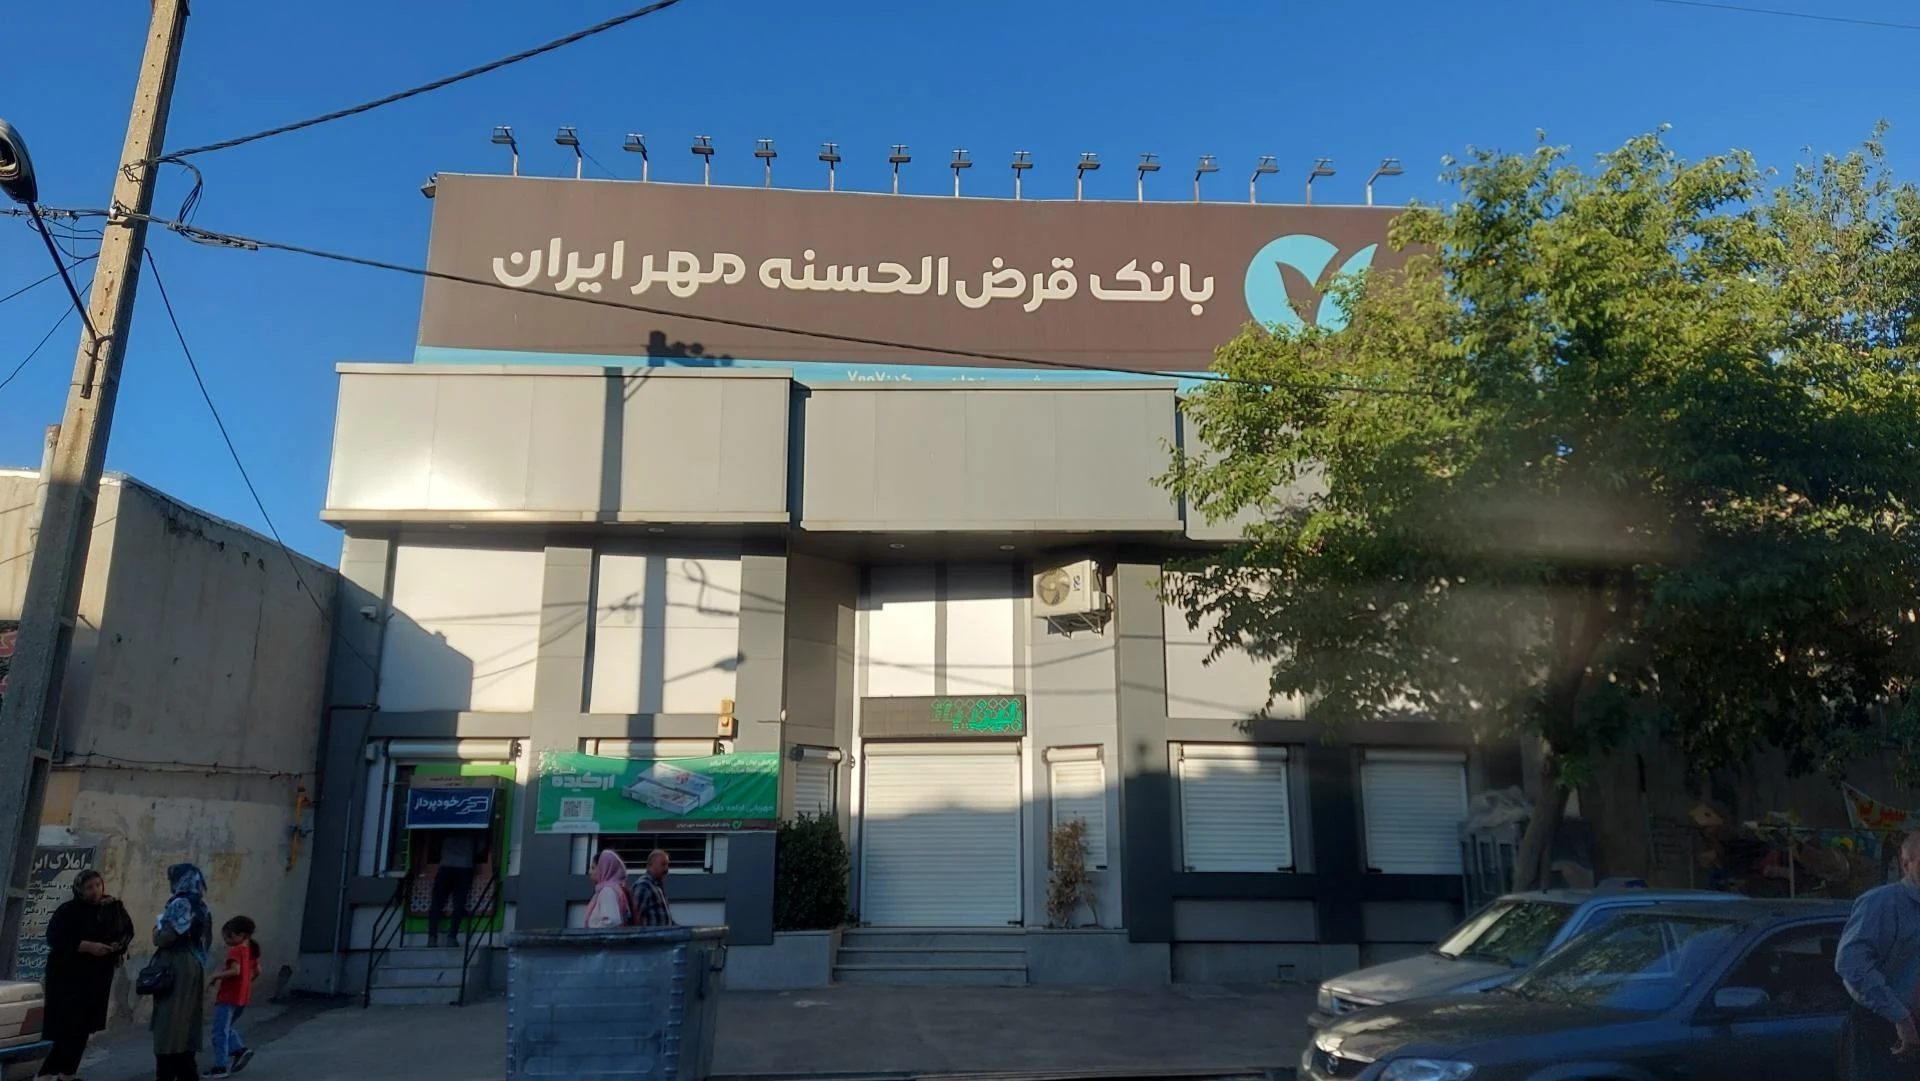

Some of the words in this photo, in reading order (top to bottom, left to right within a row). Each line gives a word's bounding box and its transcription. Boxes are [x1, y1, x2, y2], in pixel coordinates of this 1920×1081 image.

[493, 238, 624, 292] ایران
[631, 251, 745, 297] مهر
[759, 250, 948, 295] الحسنه
[956, 258, 1077, 312] قرض
[1090, 259, 1213, 315] بانک
[551, 771, 615, 792] ارکیده
[414, 797, 468, 816] خودپرداز
[49, 852, 86, 870] املاک
